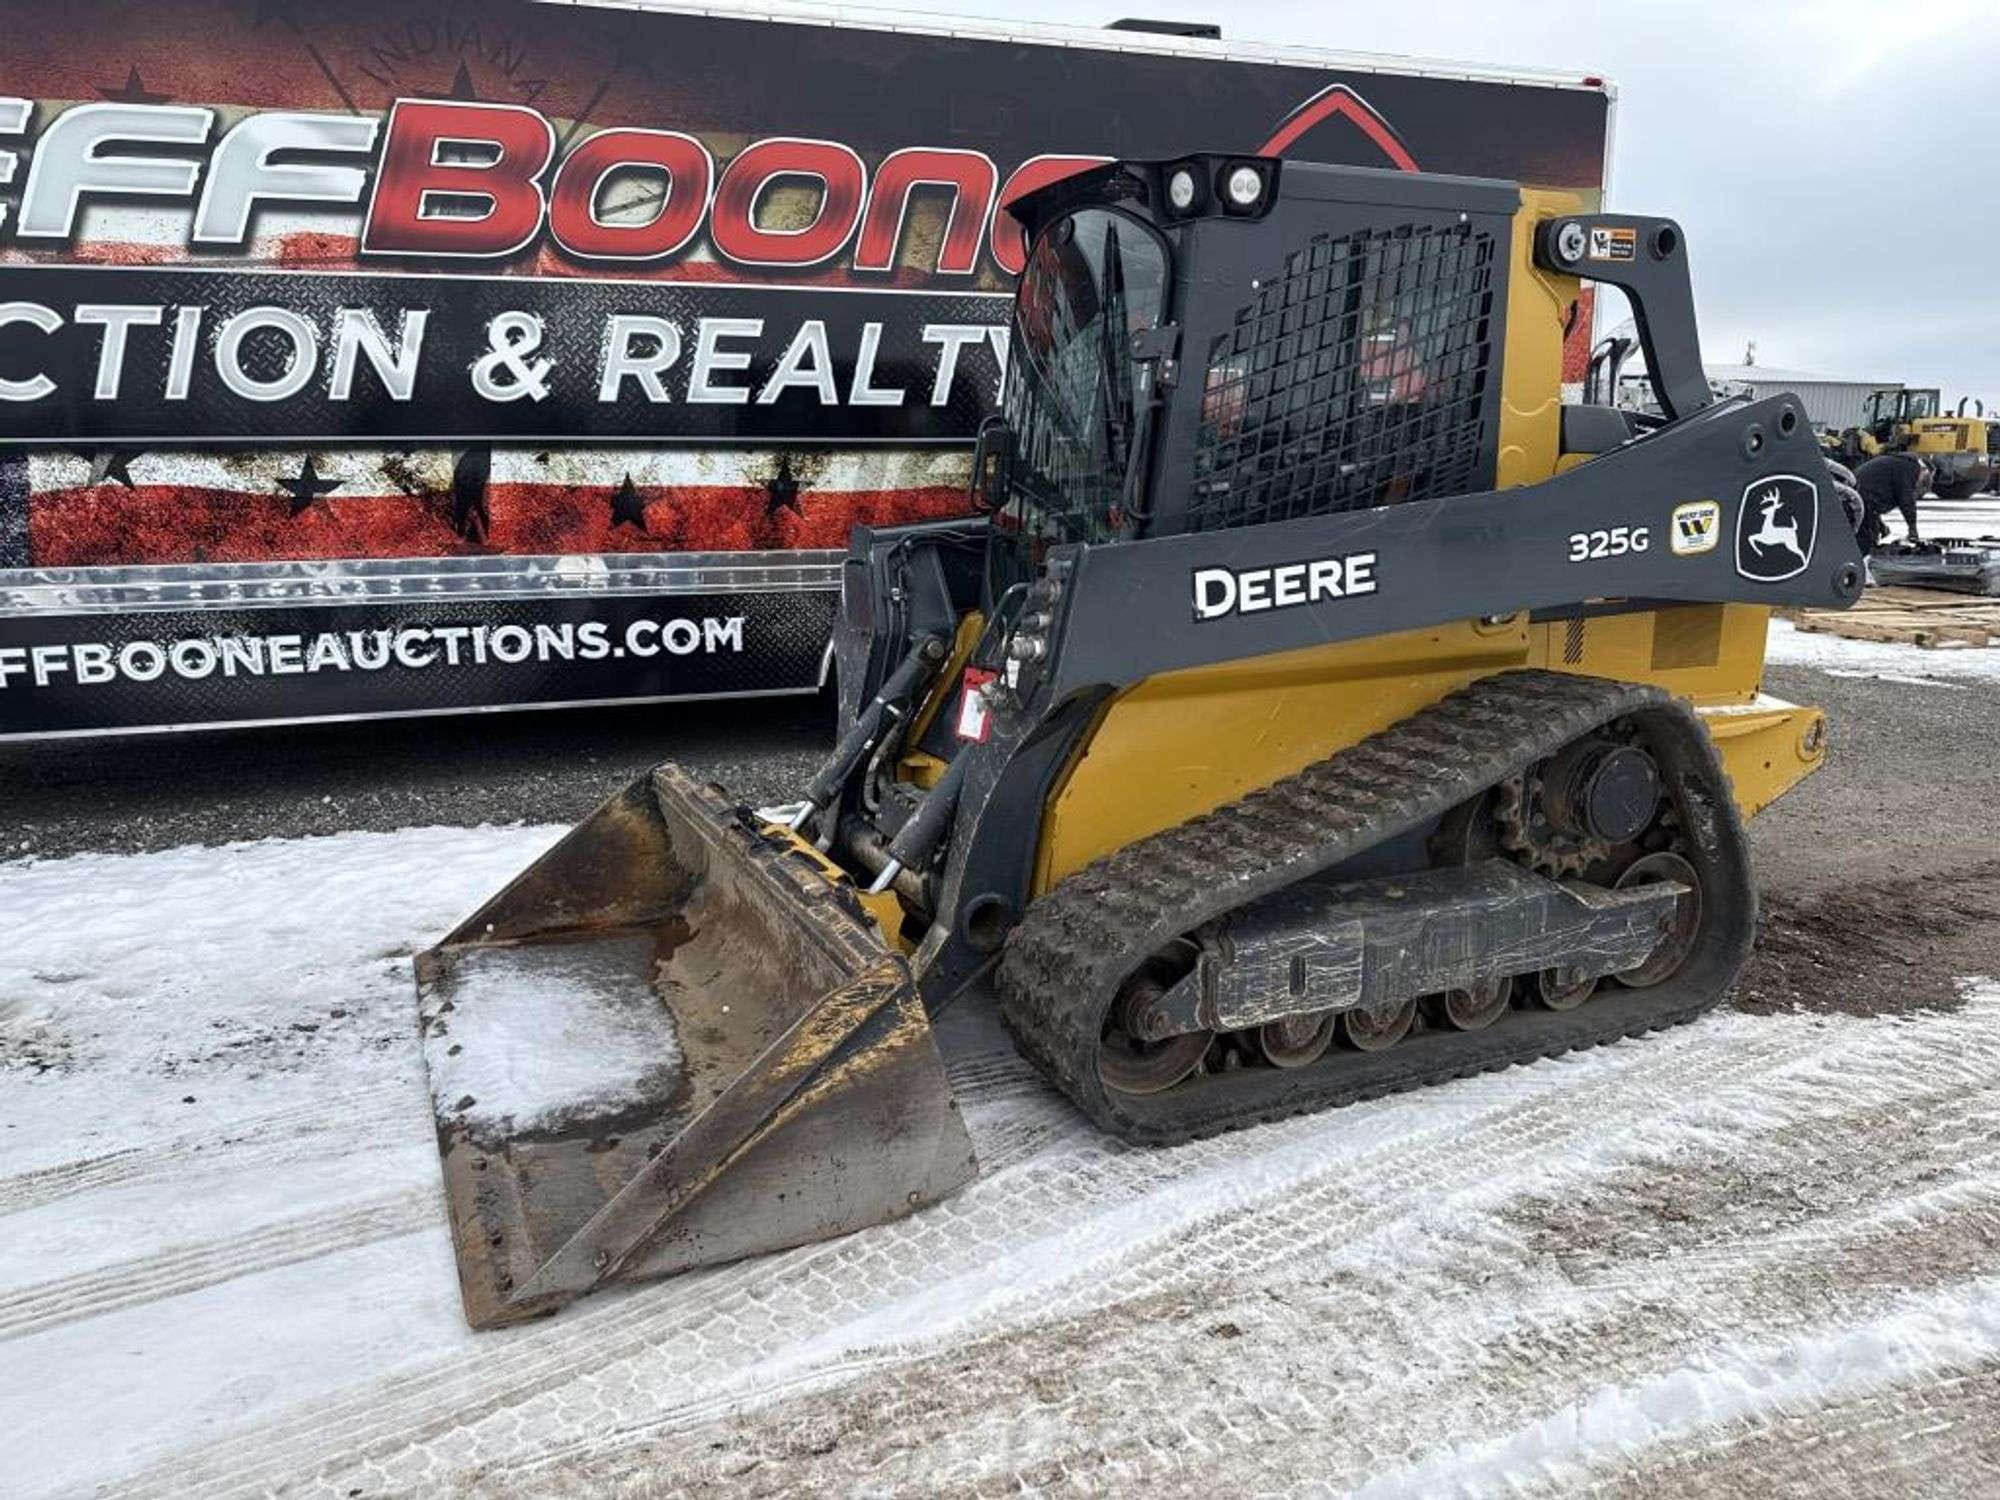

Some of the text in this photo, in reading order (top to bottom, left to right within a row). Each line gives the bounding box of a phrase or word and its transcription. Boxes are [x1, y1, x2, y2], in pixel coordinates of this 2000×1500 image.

[469, 310, 558, 403] &
[1568, 526, 1650, 563] 325G
[1194, 553, 1377, 620] DEERE
